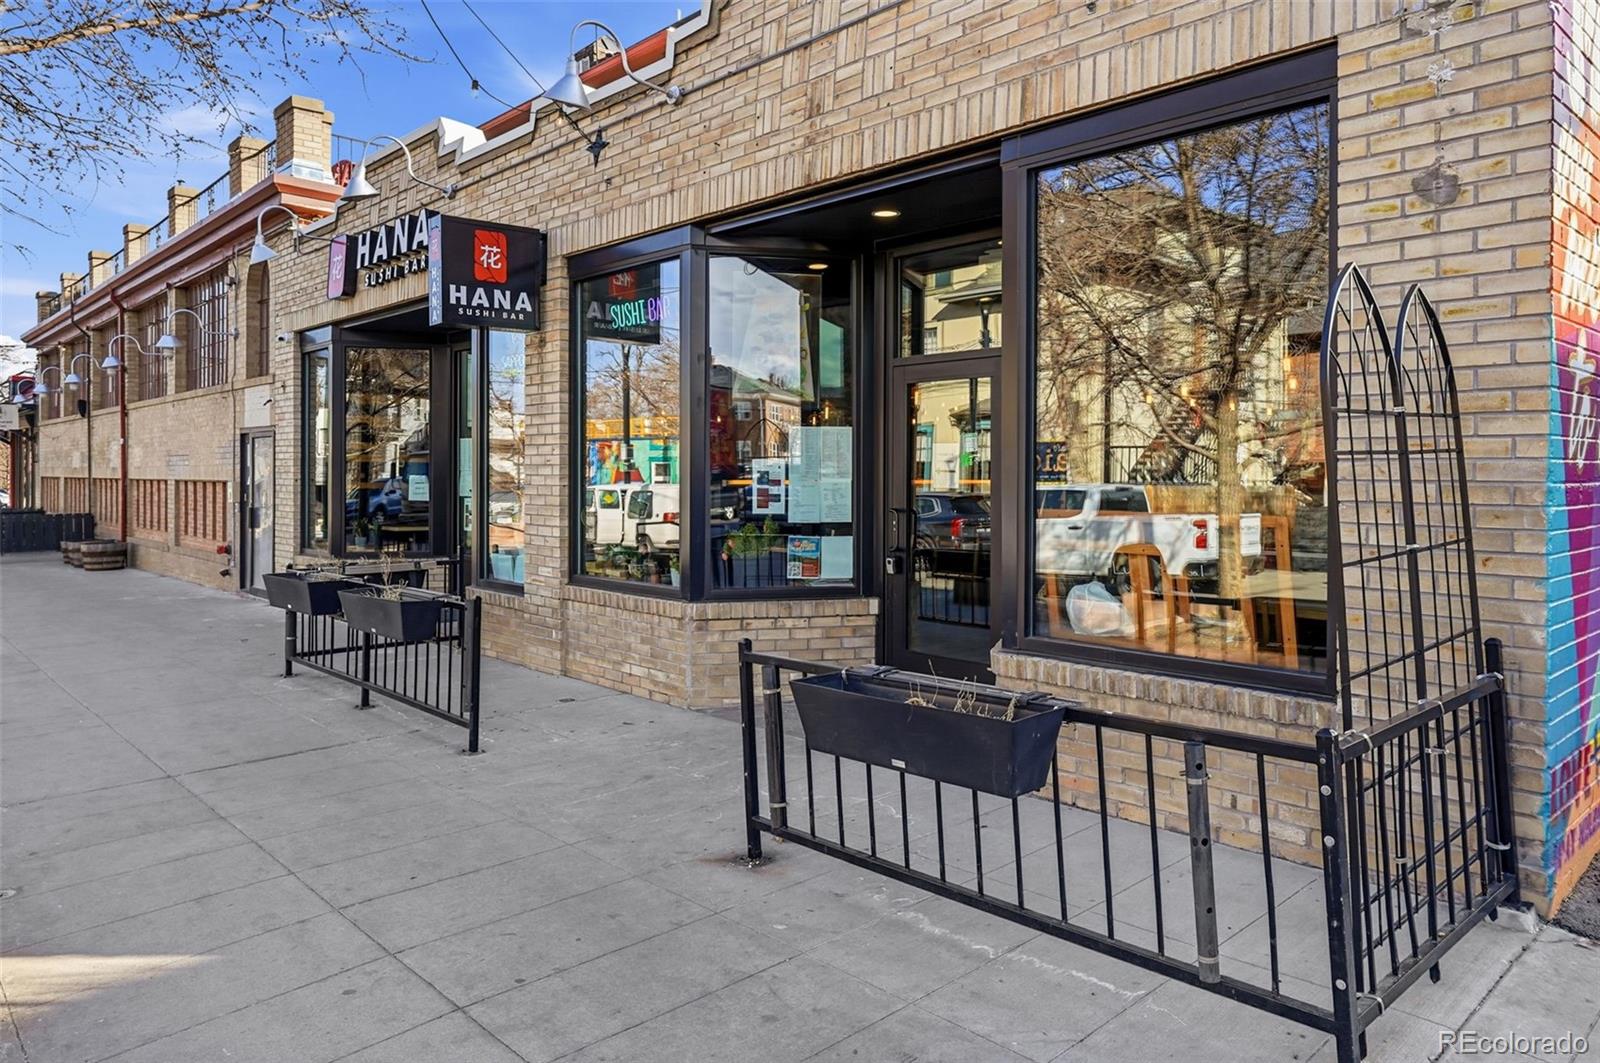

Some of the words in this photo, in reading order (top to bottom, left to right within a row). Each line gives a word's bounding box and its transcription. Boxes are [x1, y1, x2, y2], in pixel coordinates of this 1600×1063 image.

[356, 208, 429, 270] HANA
[364, 265, 398, 287] SUSHI
[404, 254, 426, 274] BAR
[480, 244, 502, 269] 花
[449, 284, 533, 312] HANA
[610, 299, 647, 329] SUSHI
[647, 295, 671, 322] BAR
[458, 307, 495, 318] SUSHI
[502, 311, 525, 321] BAR
